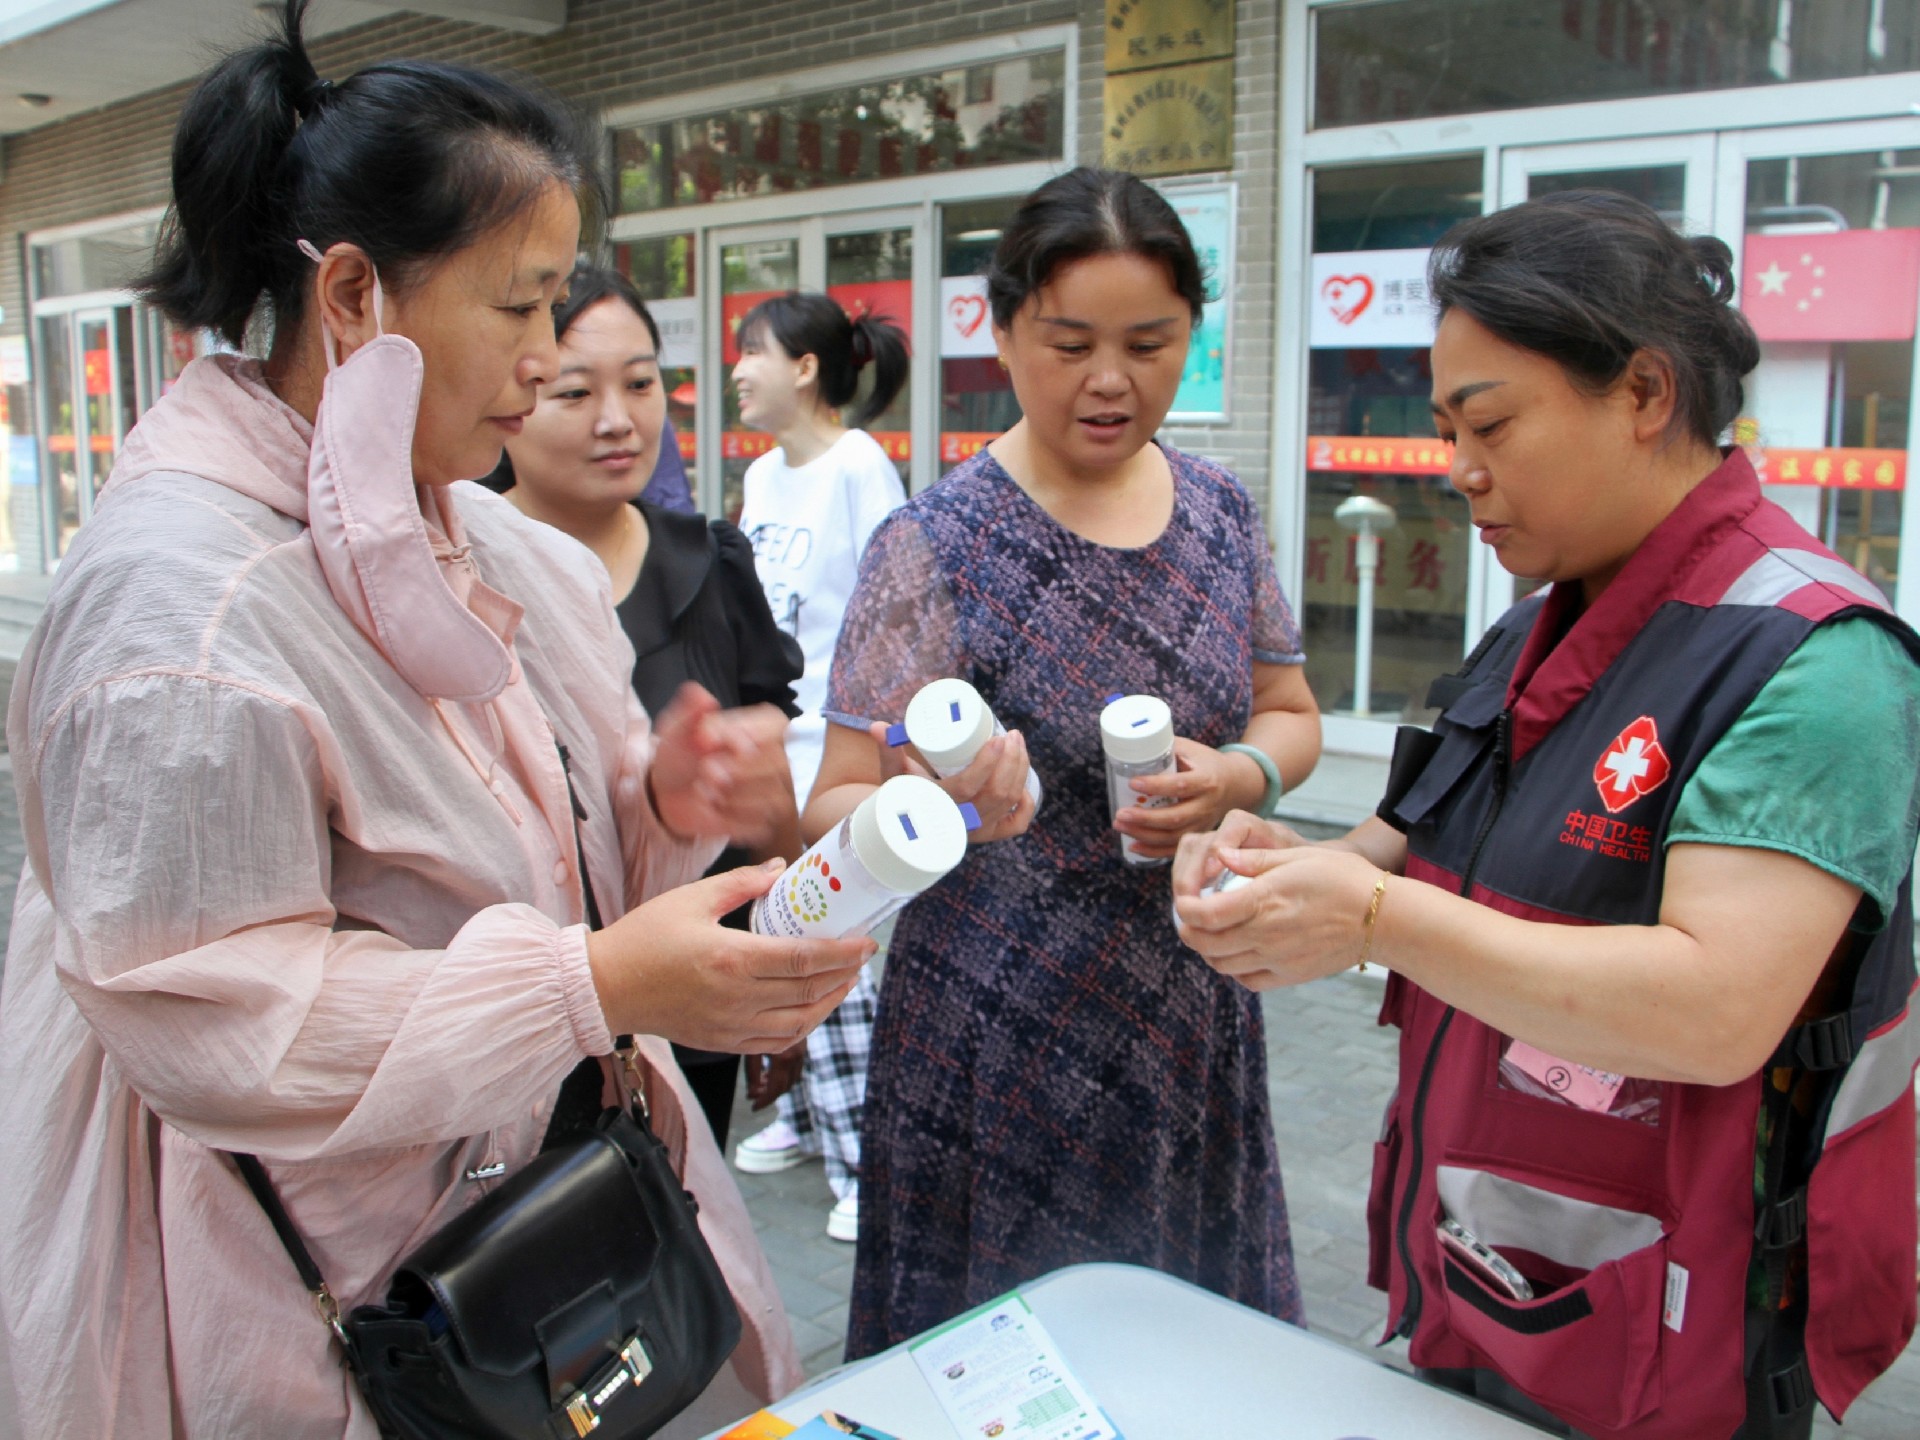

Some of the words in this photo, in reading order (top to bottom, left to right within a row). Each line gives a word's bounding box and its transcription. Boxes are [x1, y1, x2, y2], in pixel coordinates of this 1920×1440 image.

[1559, 831, 1594, 851] CHINA
[1599, 844, 1650, 862] HEALTH
[1565, 810, 1651, 850] 中国卫生
